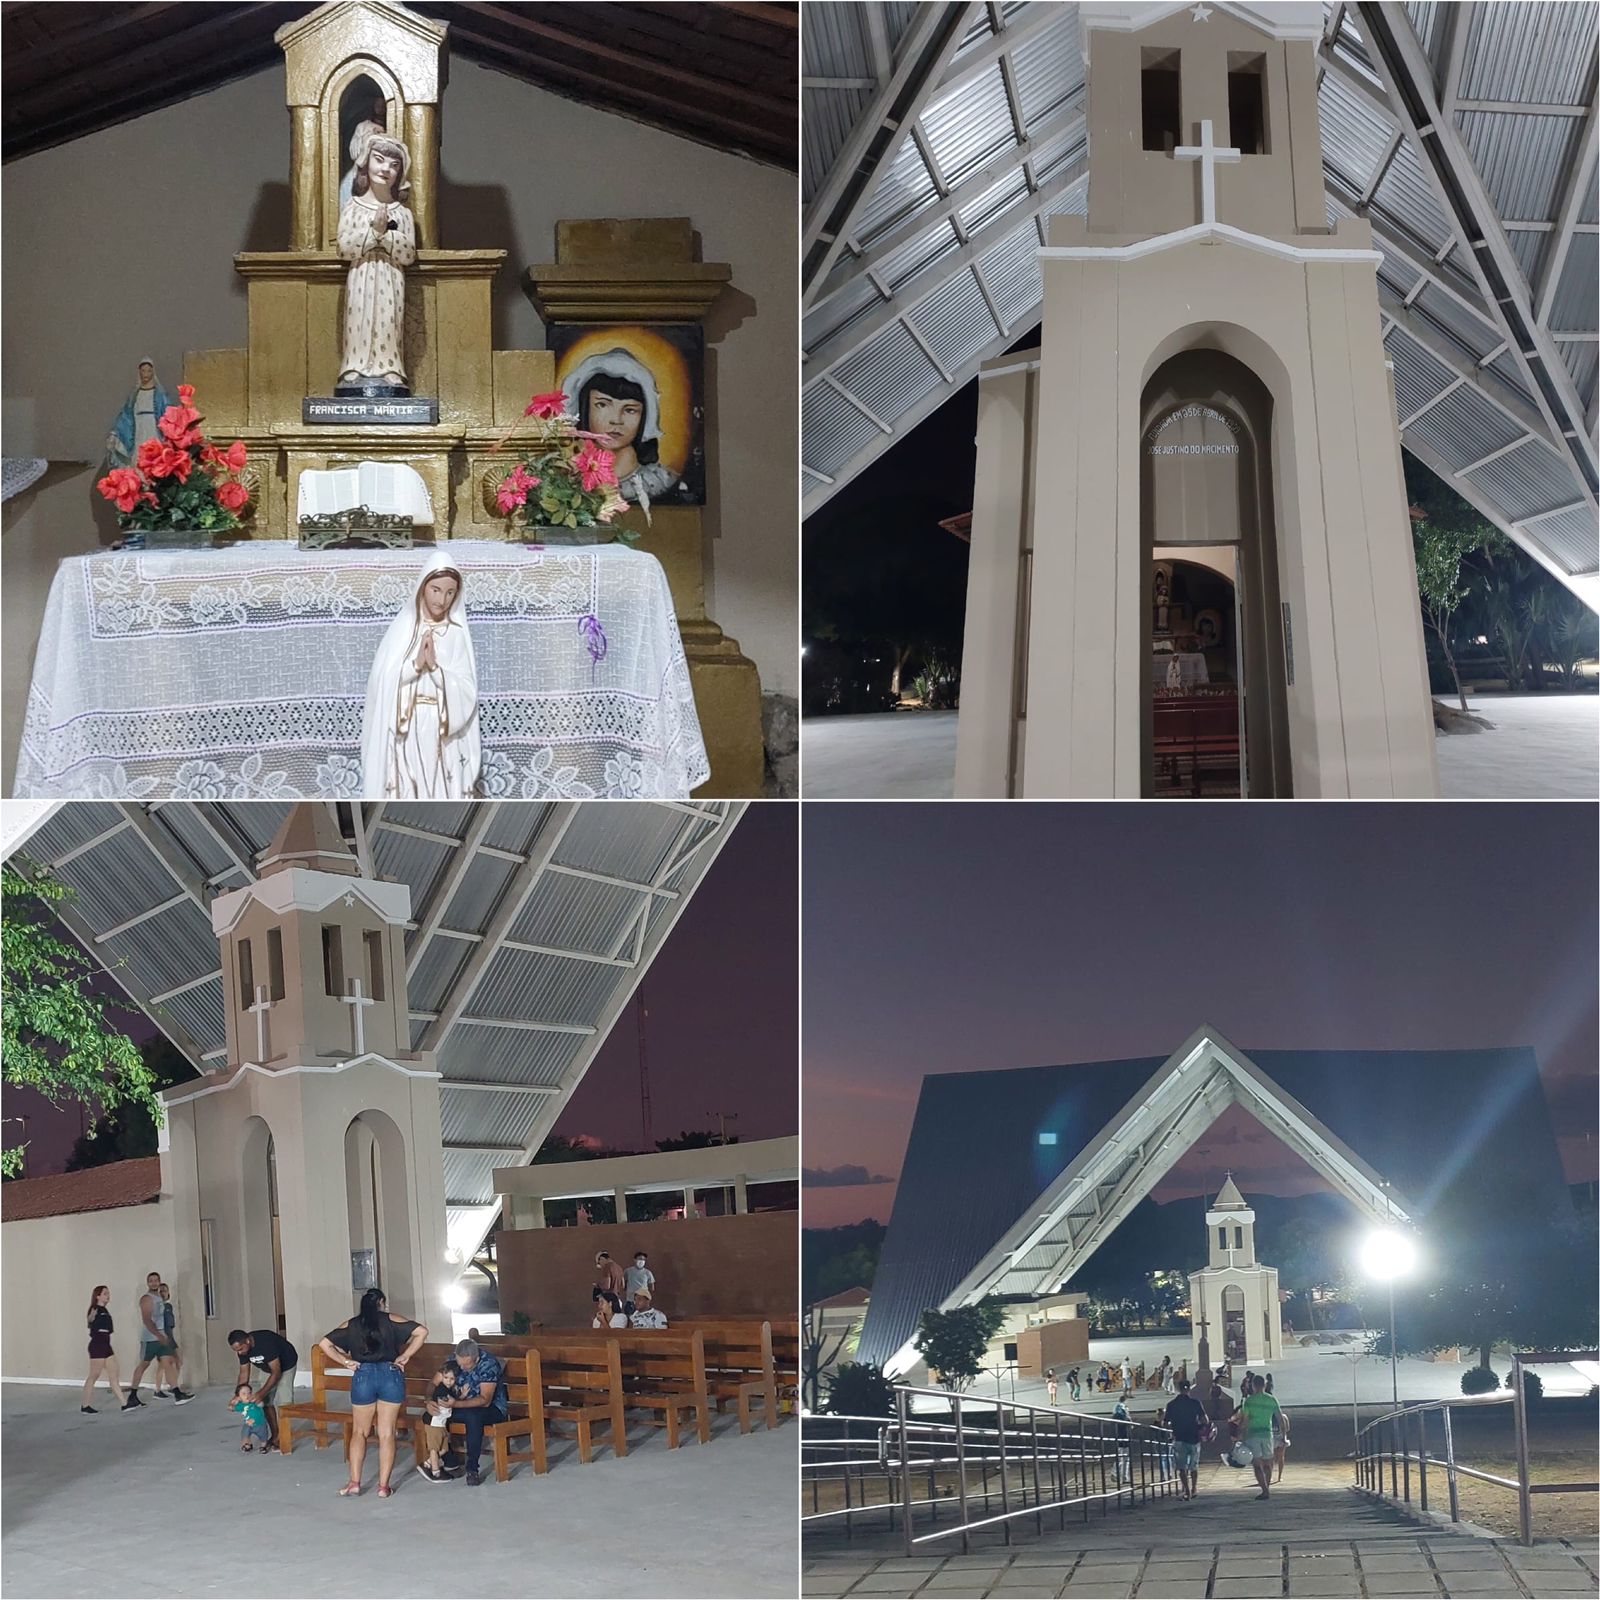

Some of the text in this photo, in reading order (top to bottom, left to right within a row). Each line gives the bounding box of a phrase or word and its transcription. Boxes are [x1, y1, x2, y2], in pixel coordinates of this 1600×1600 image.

[309, 402, 413, 416] FRANCISCA MÁRTIR
[1193, 407, 1202, 417] DE
[1190, 445, 1200, 454] DO
